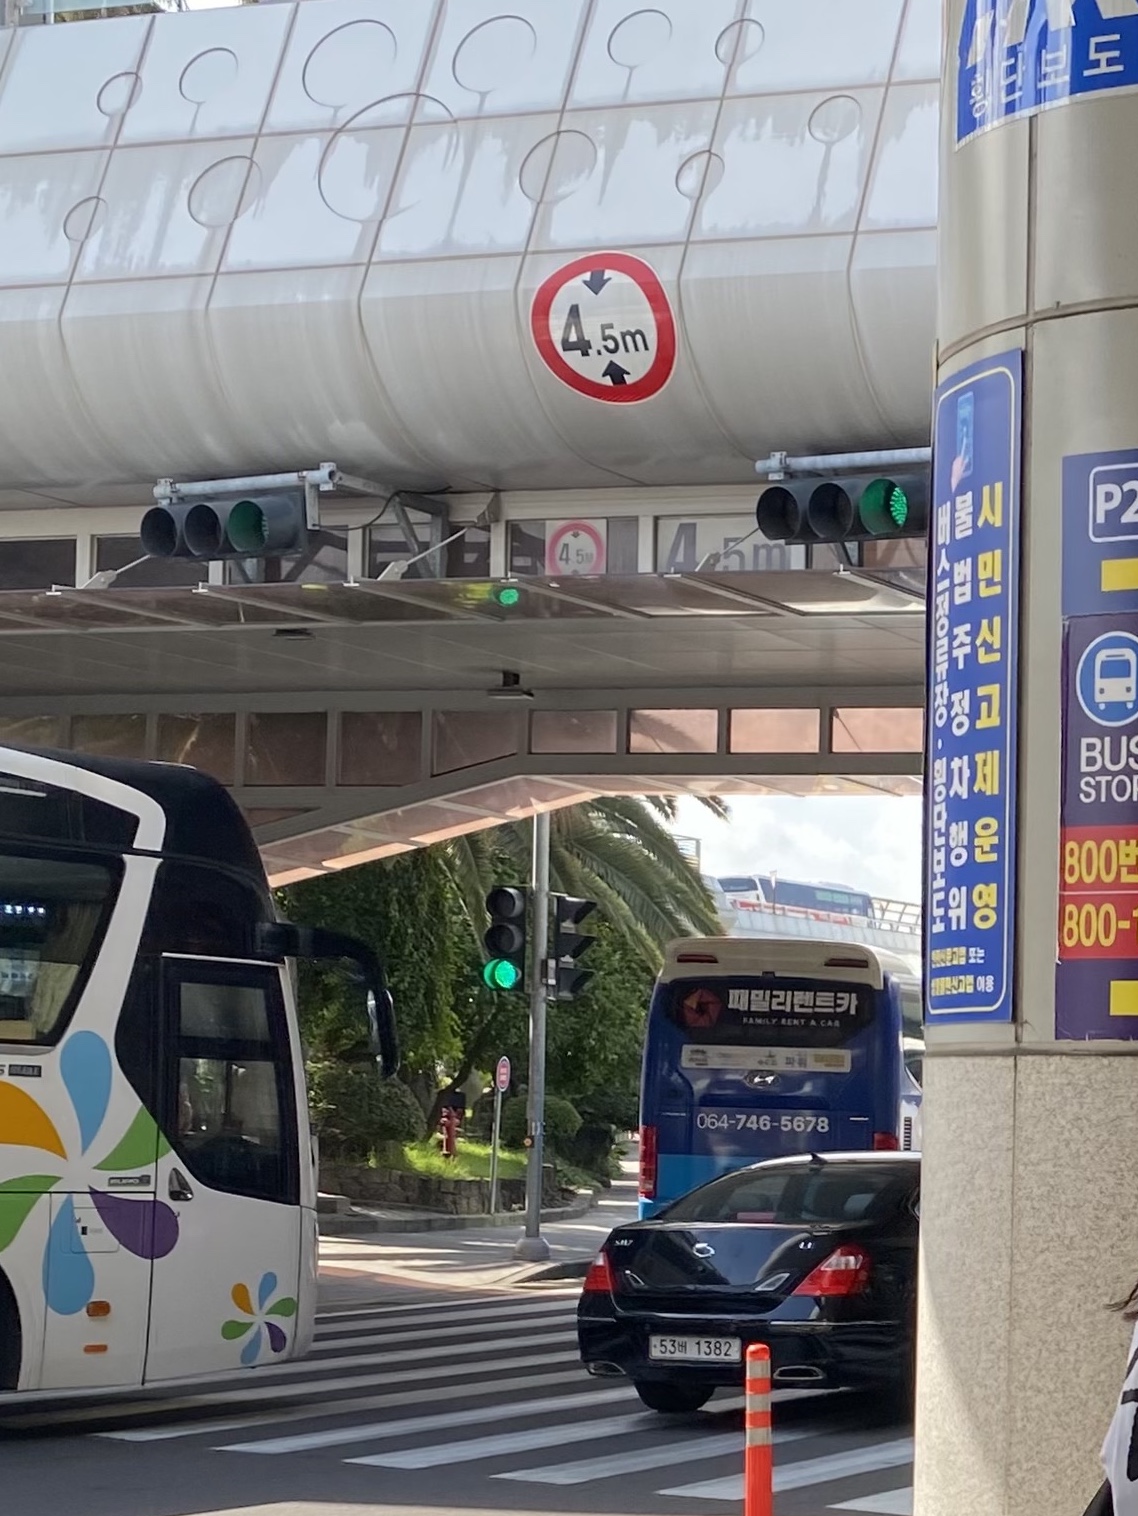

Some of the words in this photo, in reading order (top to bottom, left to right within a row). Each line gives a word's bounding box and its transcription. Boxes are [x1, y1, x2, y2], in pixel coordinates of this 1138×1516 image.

[971, 33, 1125, 119] 횡단보도
[561, 304, 650, 357] 4.5m
[948, 490, 974, 931] 불법주정차행위
[972, 481, 1004, 930] 시민신고제운영
[727, 988, 858, 1015] 패밀리렌트카
[696, 1112, 830, 1133] 064-746-5678
[695, 1340, 732, 1357] 1382
